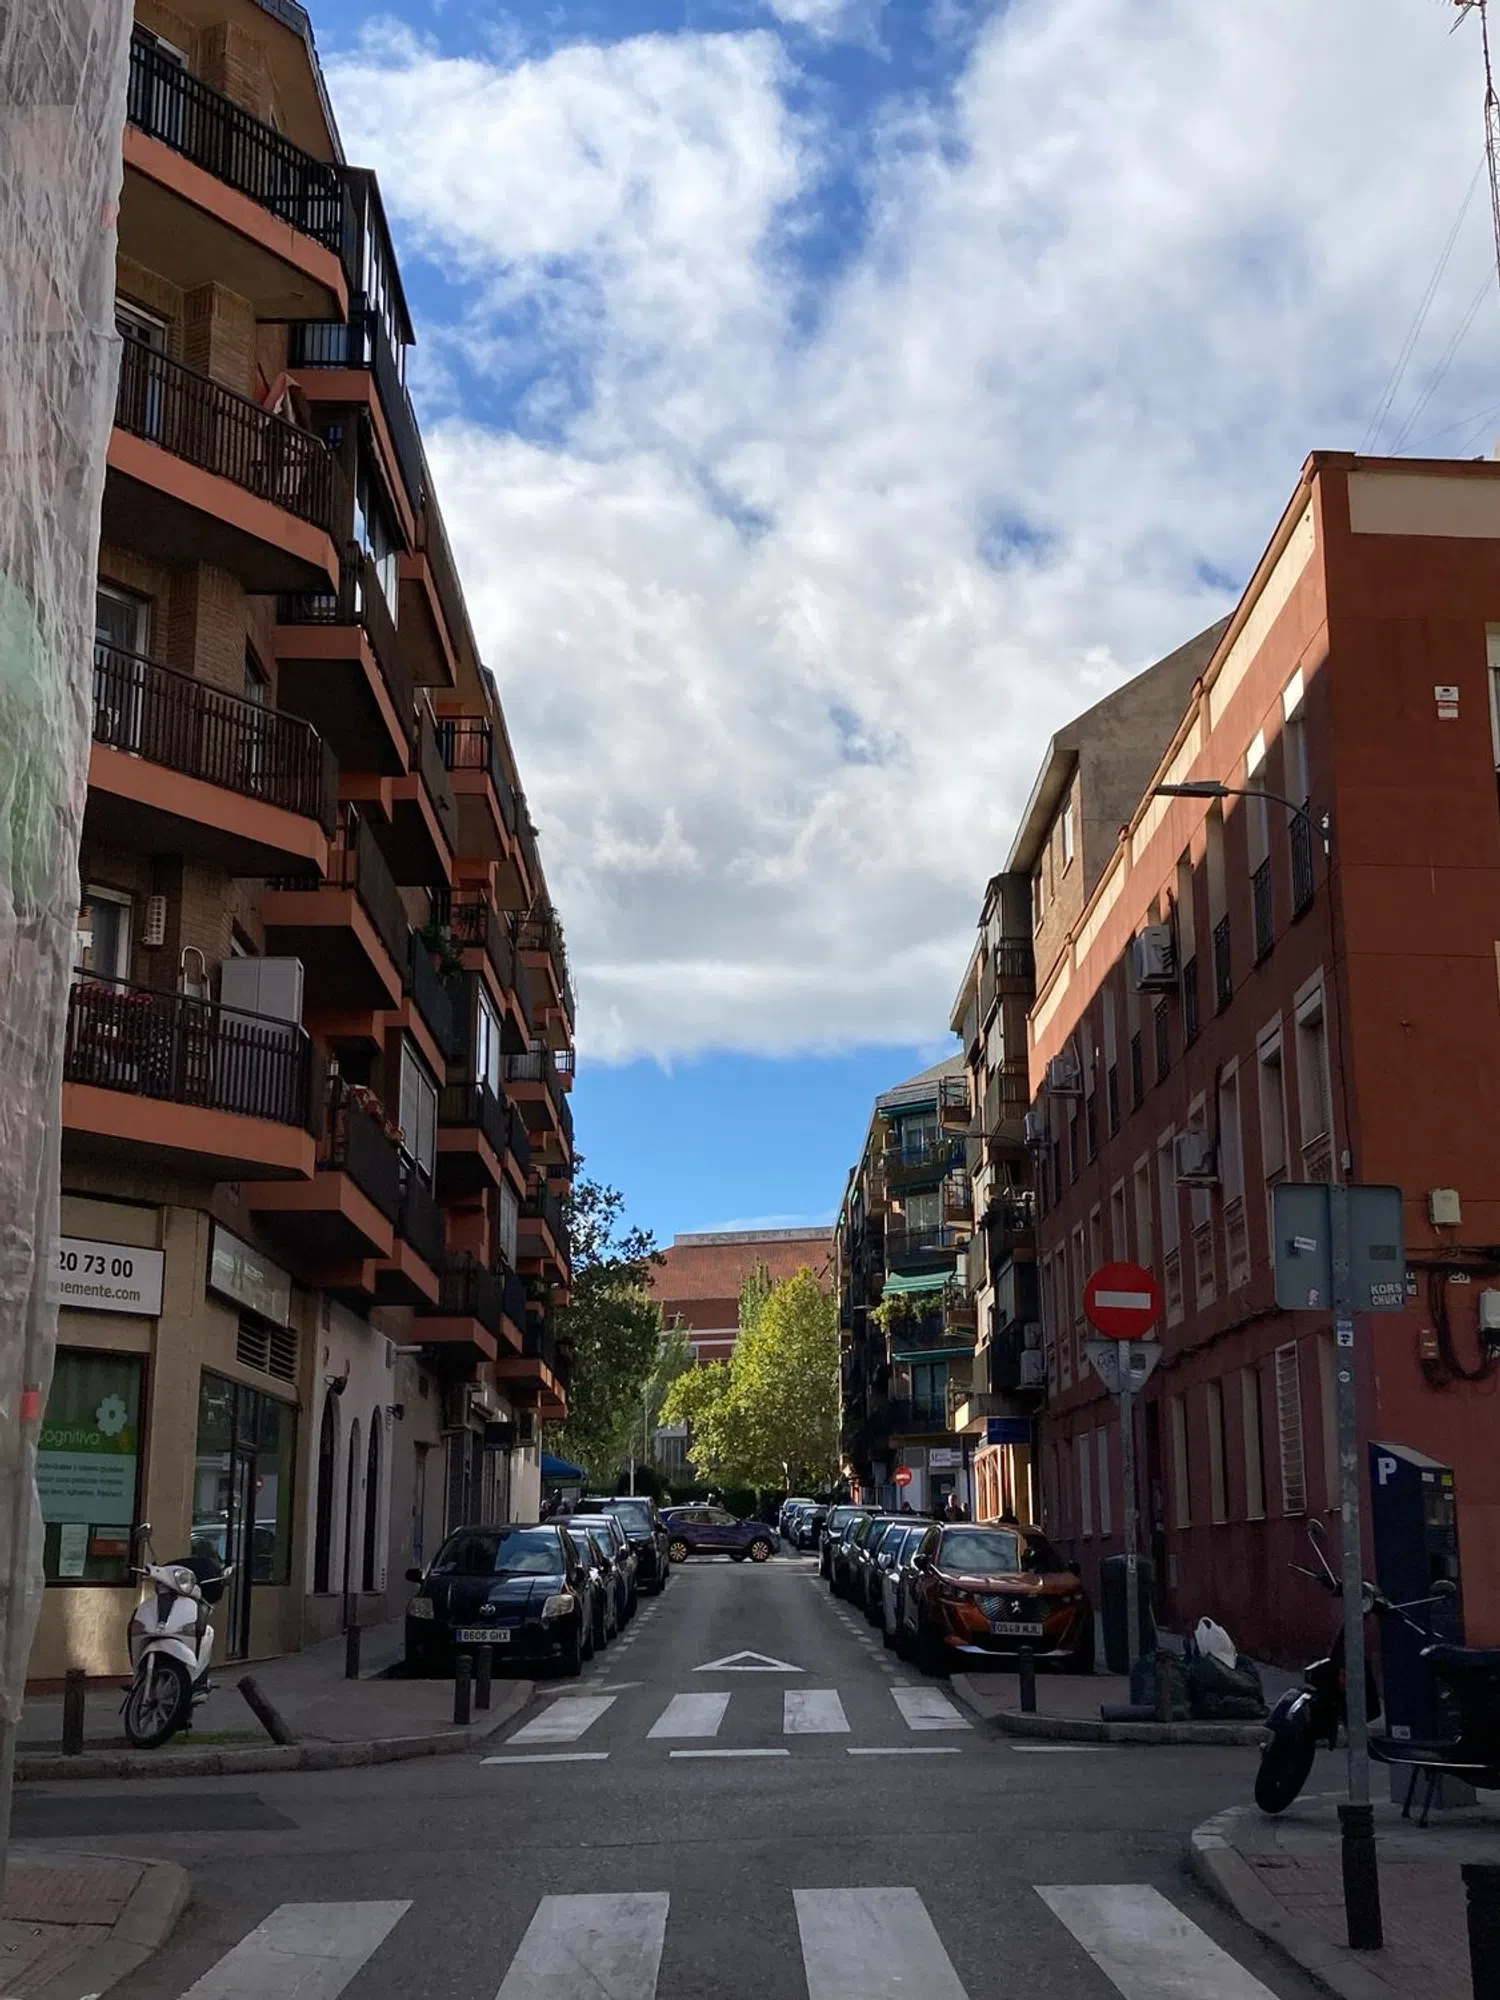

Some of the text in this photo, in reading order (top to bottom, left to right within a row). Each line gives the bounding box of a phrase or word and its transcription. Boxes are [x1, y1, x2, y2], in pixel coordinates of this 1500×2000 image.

[60, 1251, 133, 1278] 20 73 00
[1371, 1283, 1402, 1295] KORS
[1372, 1294, 1403, 1306] CHUKY
[1378, 1457, 1397, 1485] P
